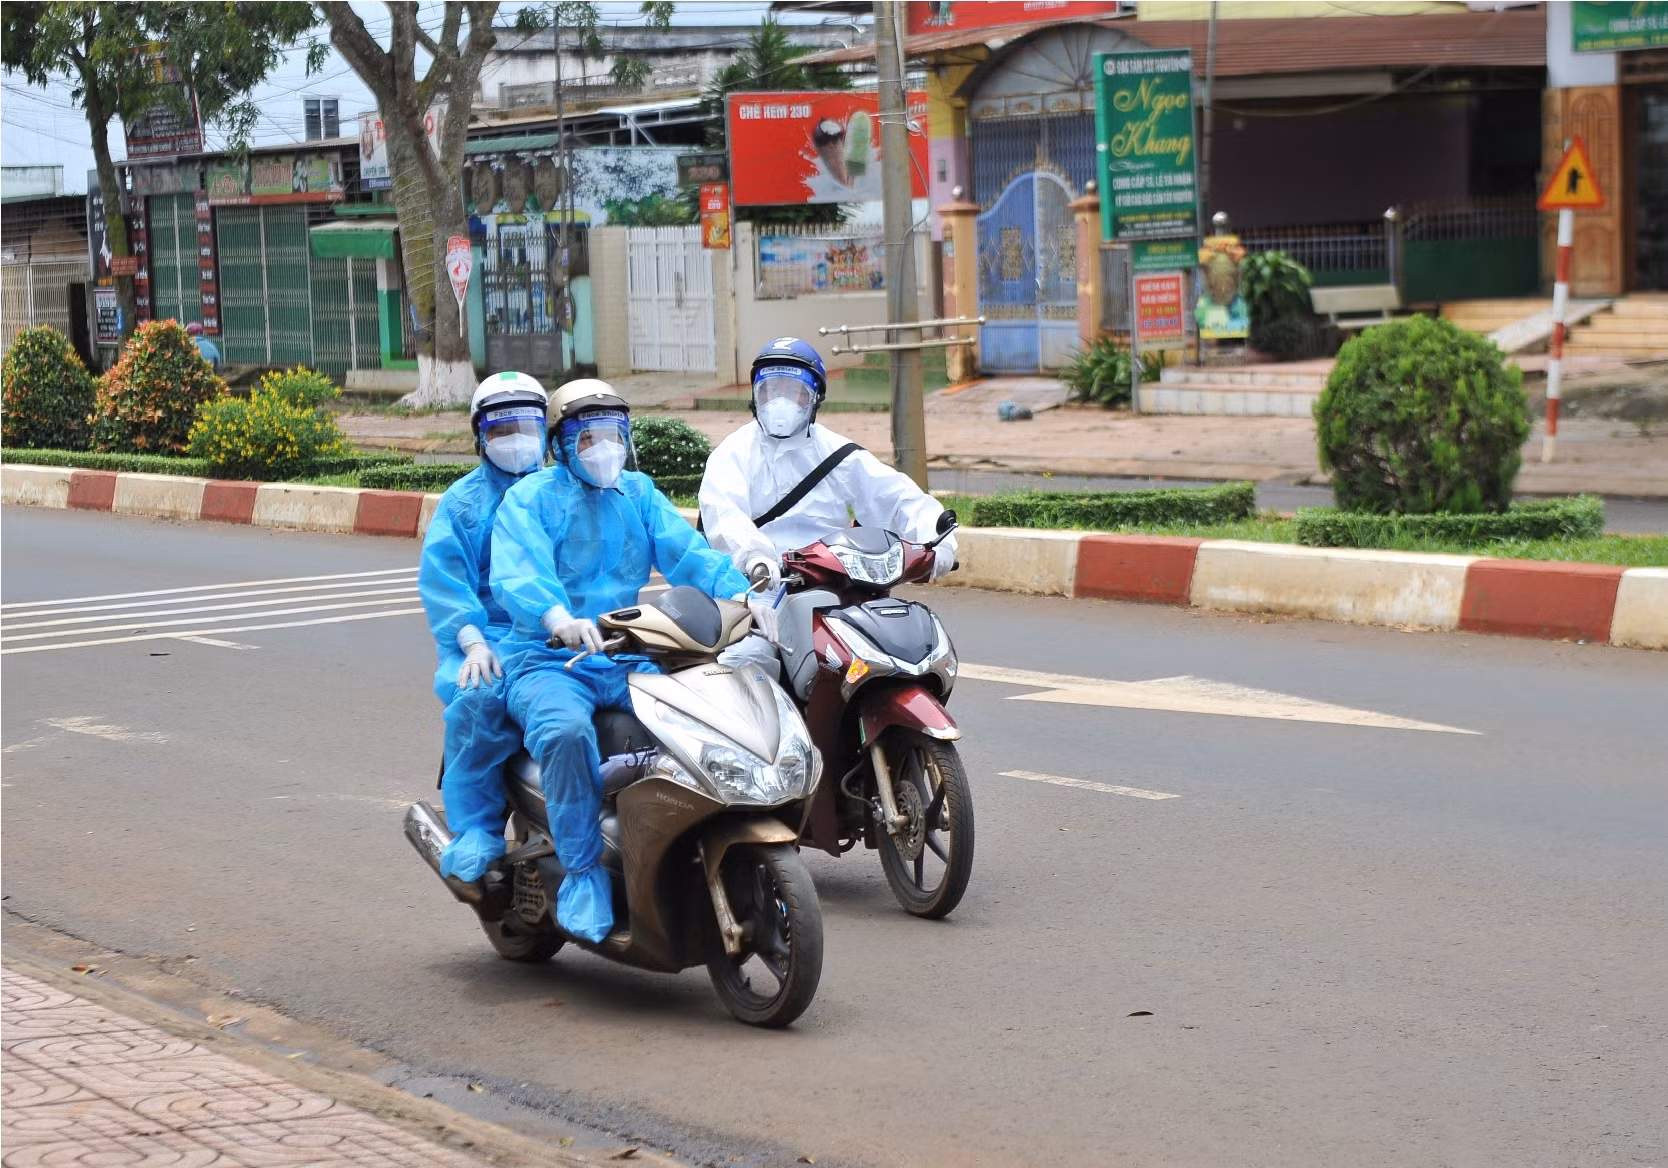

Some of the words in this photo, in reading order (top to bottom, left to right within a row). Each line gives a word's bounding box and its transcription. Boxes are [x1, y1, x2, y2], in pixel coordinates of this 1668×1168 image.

[789, 104, 811, 118] 230
[1111, 121, 1191, 166] Khang
[776, 366, 798, 374] Shield
[494, 410, 512, 419] Face
[582, 411, 599, 419] Face
[601, 410, 623, 419] Shield
[703, 668, 733, 676] HONDA
[656, 791, 695, 811] HONDA
